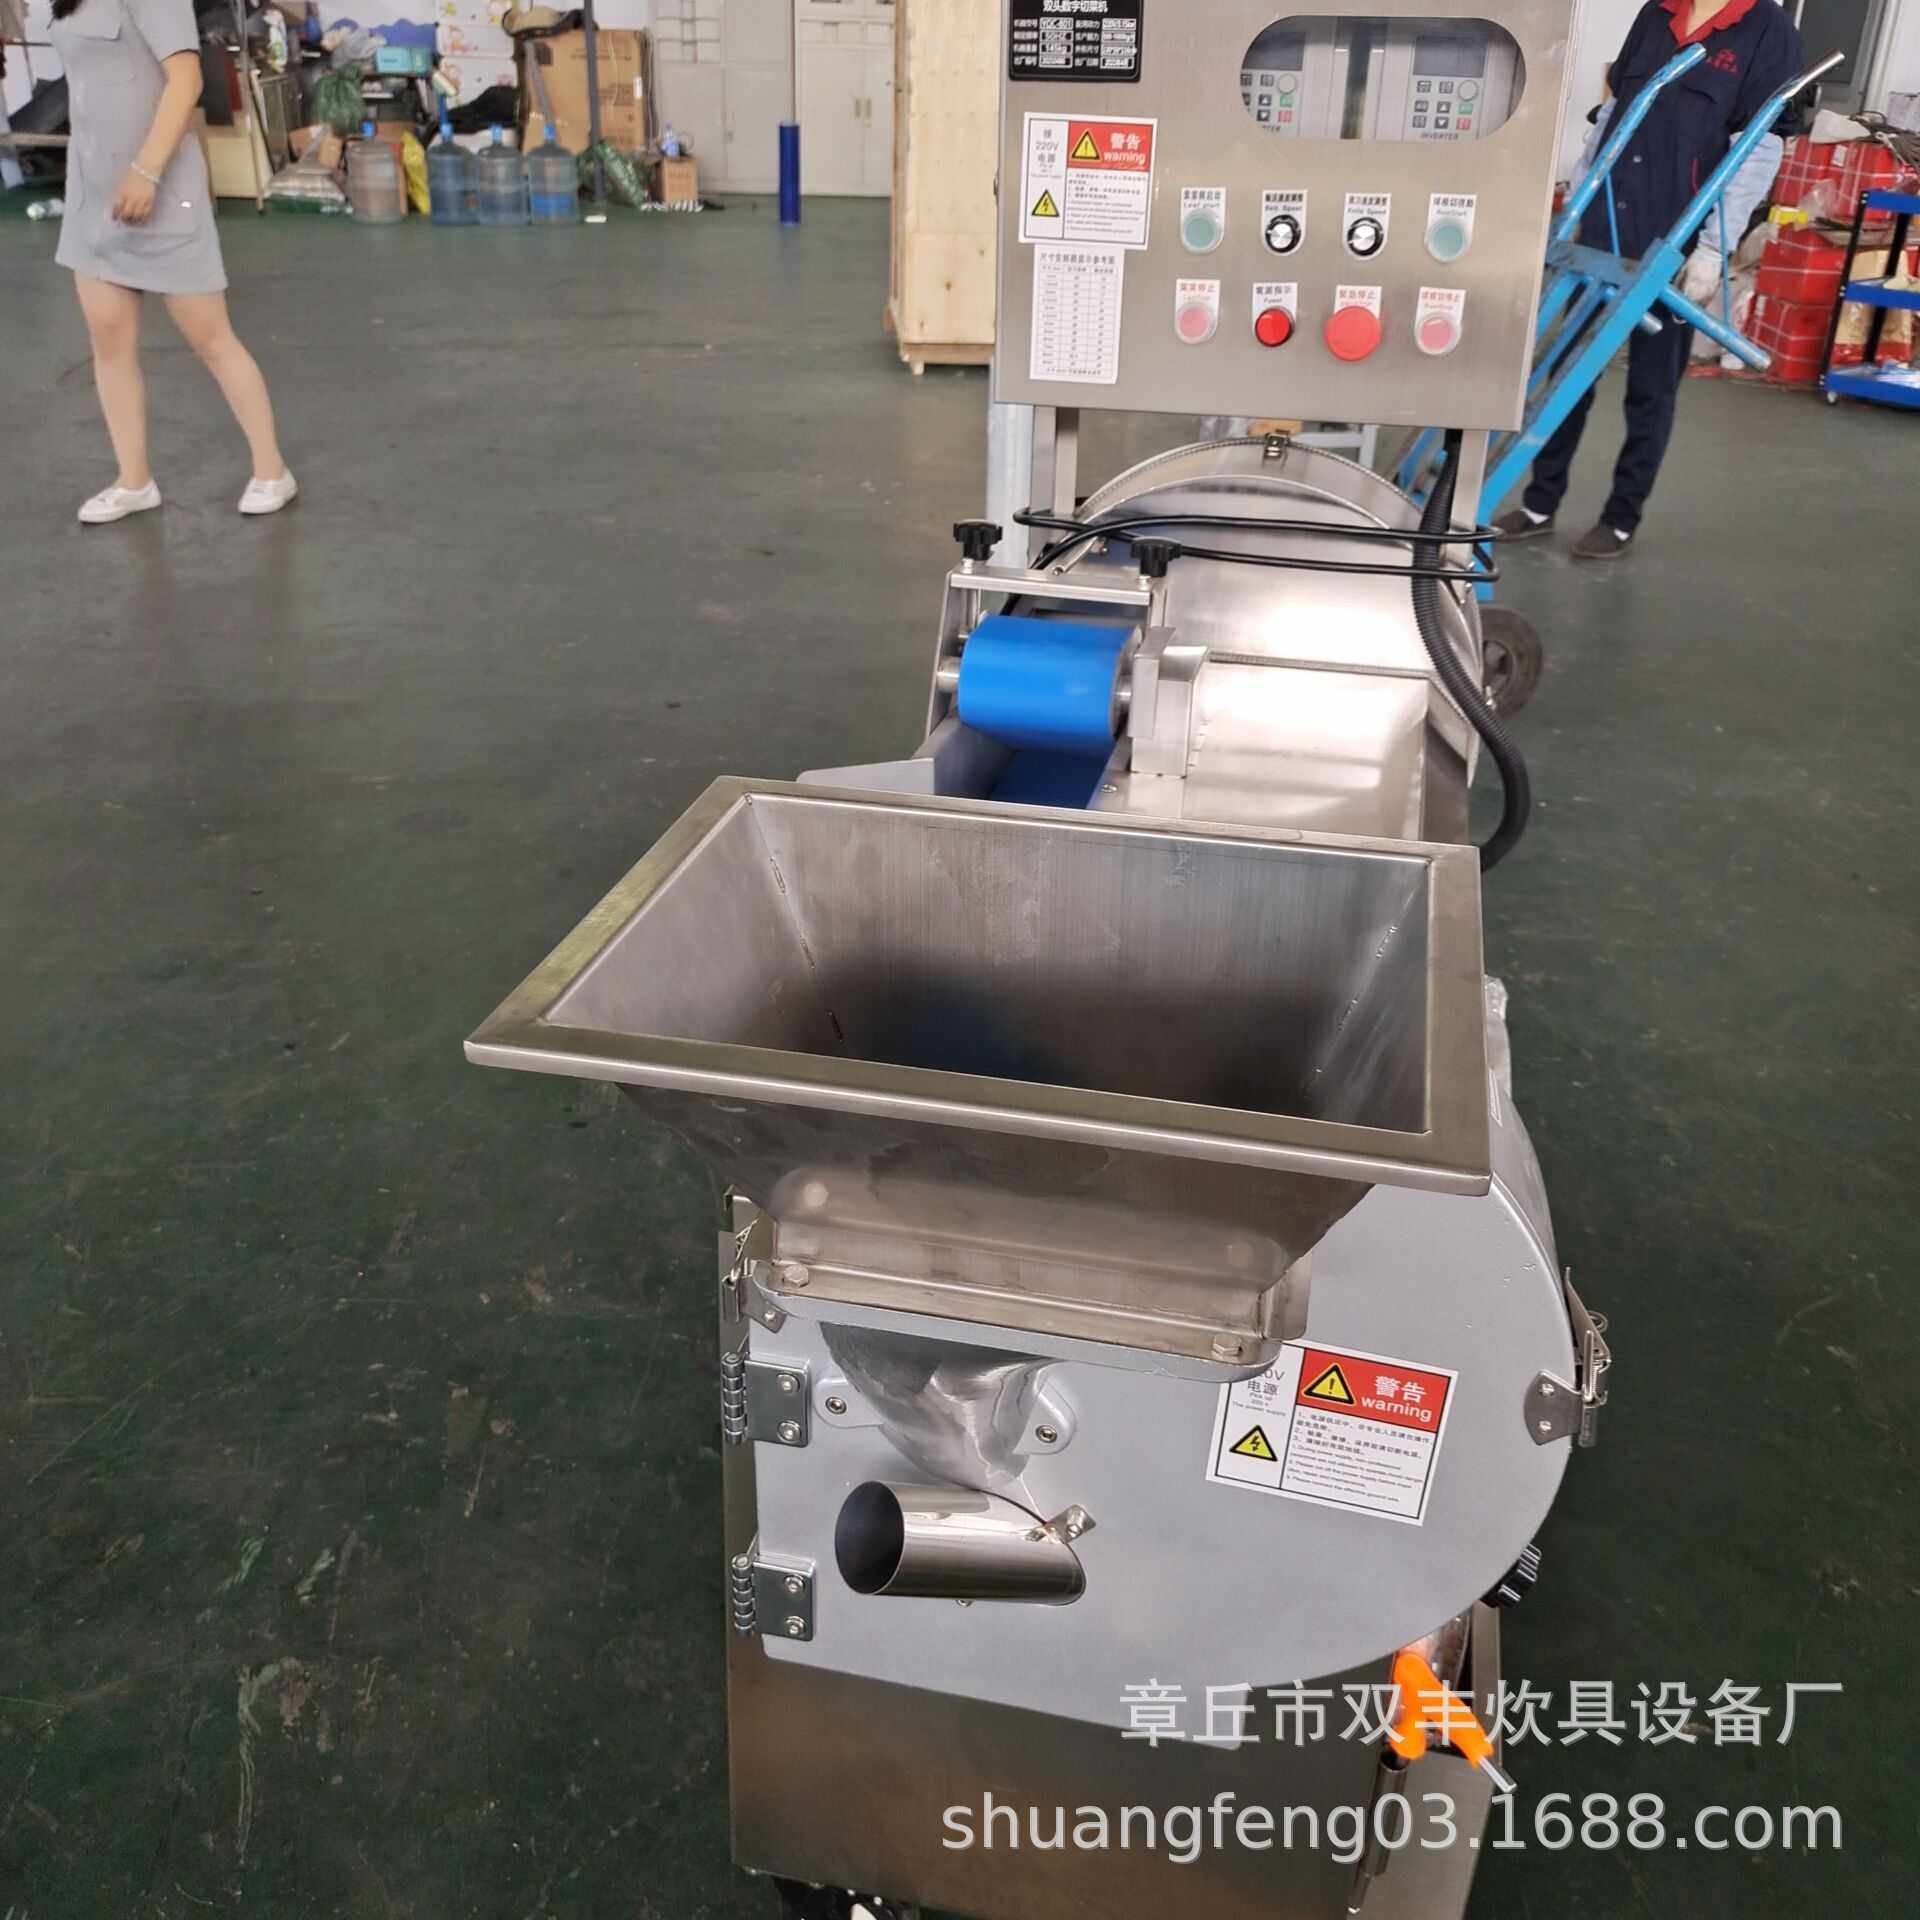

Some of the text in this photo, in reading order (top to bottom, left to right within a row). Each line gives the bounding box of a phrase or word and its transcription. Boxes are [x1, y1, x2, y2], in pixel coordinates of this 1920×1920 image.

[1035, 141, 1060, 151] 220V
[1111, 132, 1141, 151] 警告
[1104, 152, 1146, 165] warning
[1247, 1380, 1279, 1396] 电源
[1374, 1375, 1427, 1404] 警告
[1361, 1396, 1432, 1423] warning
